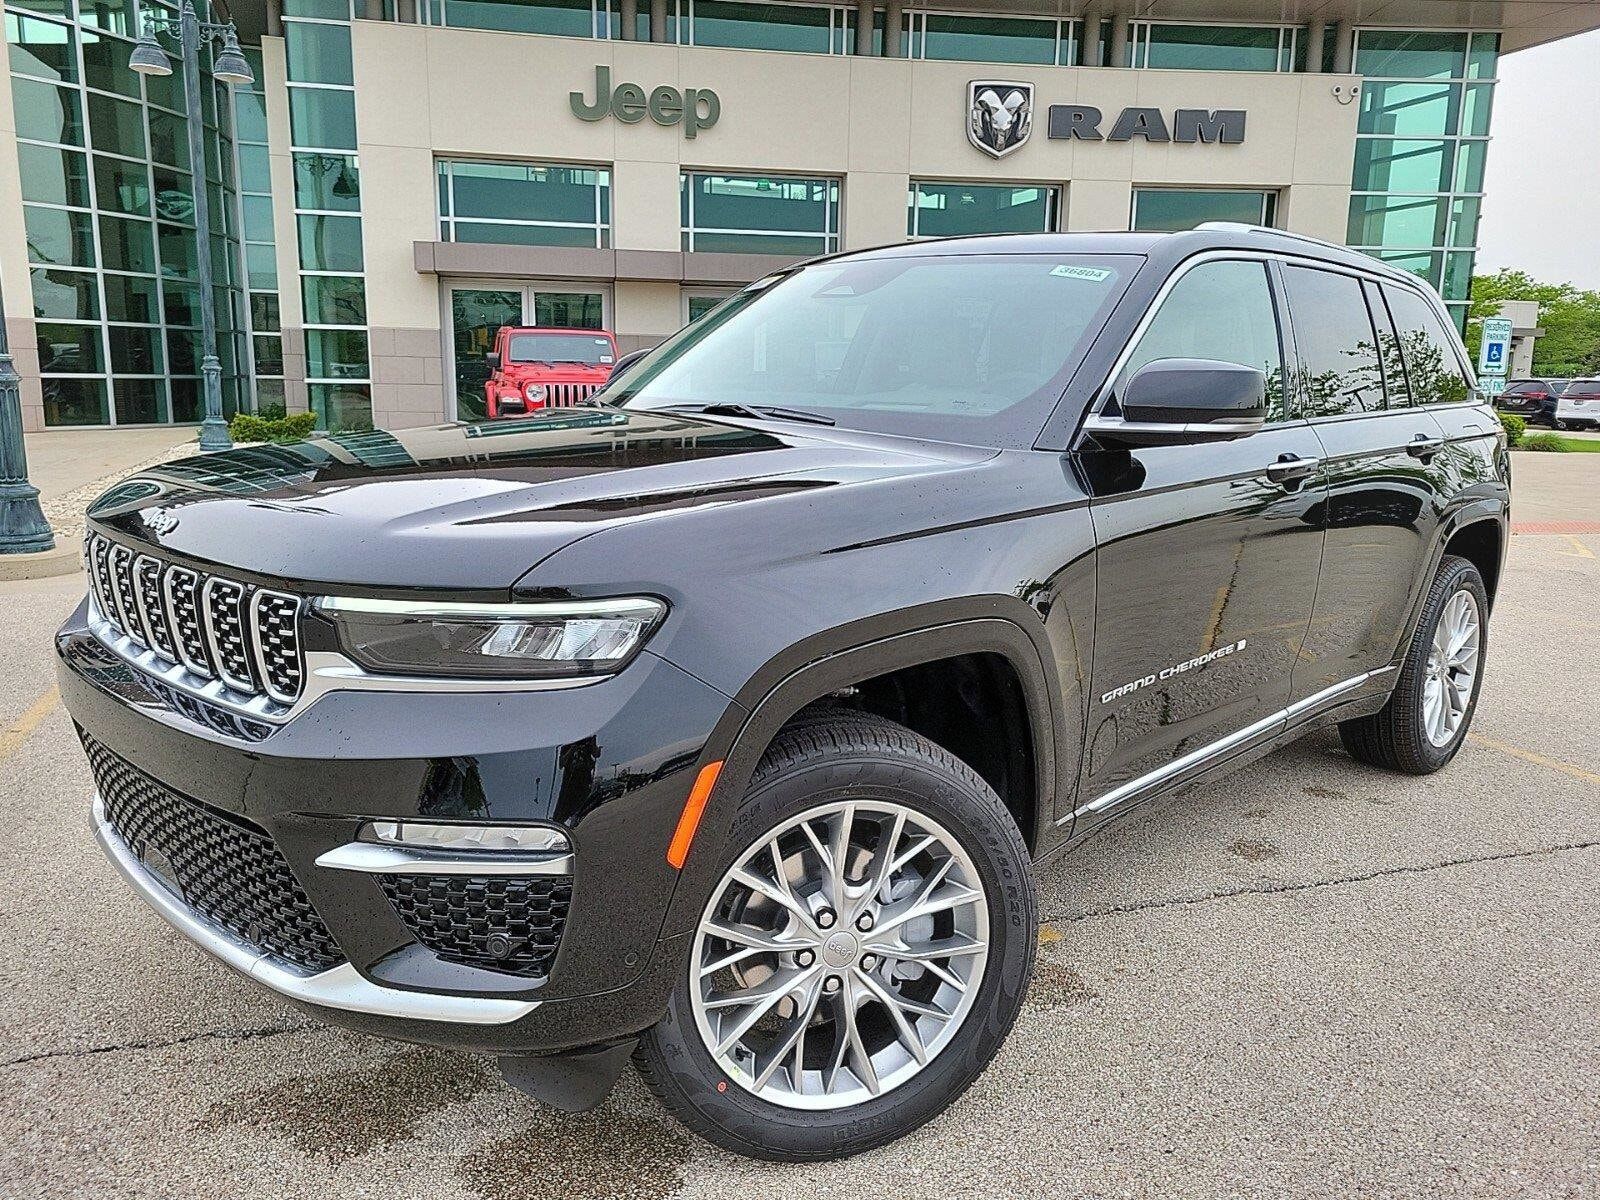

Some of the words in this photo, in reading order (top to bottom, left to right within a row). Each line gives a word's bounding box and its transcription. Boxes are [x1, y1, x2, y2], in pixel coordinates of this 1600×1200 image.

[569, 65, 721, 139] Jeep
[1048, 104, 1248, 144] RAM
[1486, 321, 1511, 332] RESERVED
[1486, 332, 1508, 342] PARKING
[142, 507, 180, 536] Jeep
[1101, 674, 1156, 704] GRAND
[1158, 643, 1235, 681] CHEROKEE
